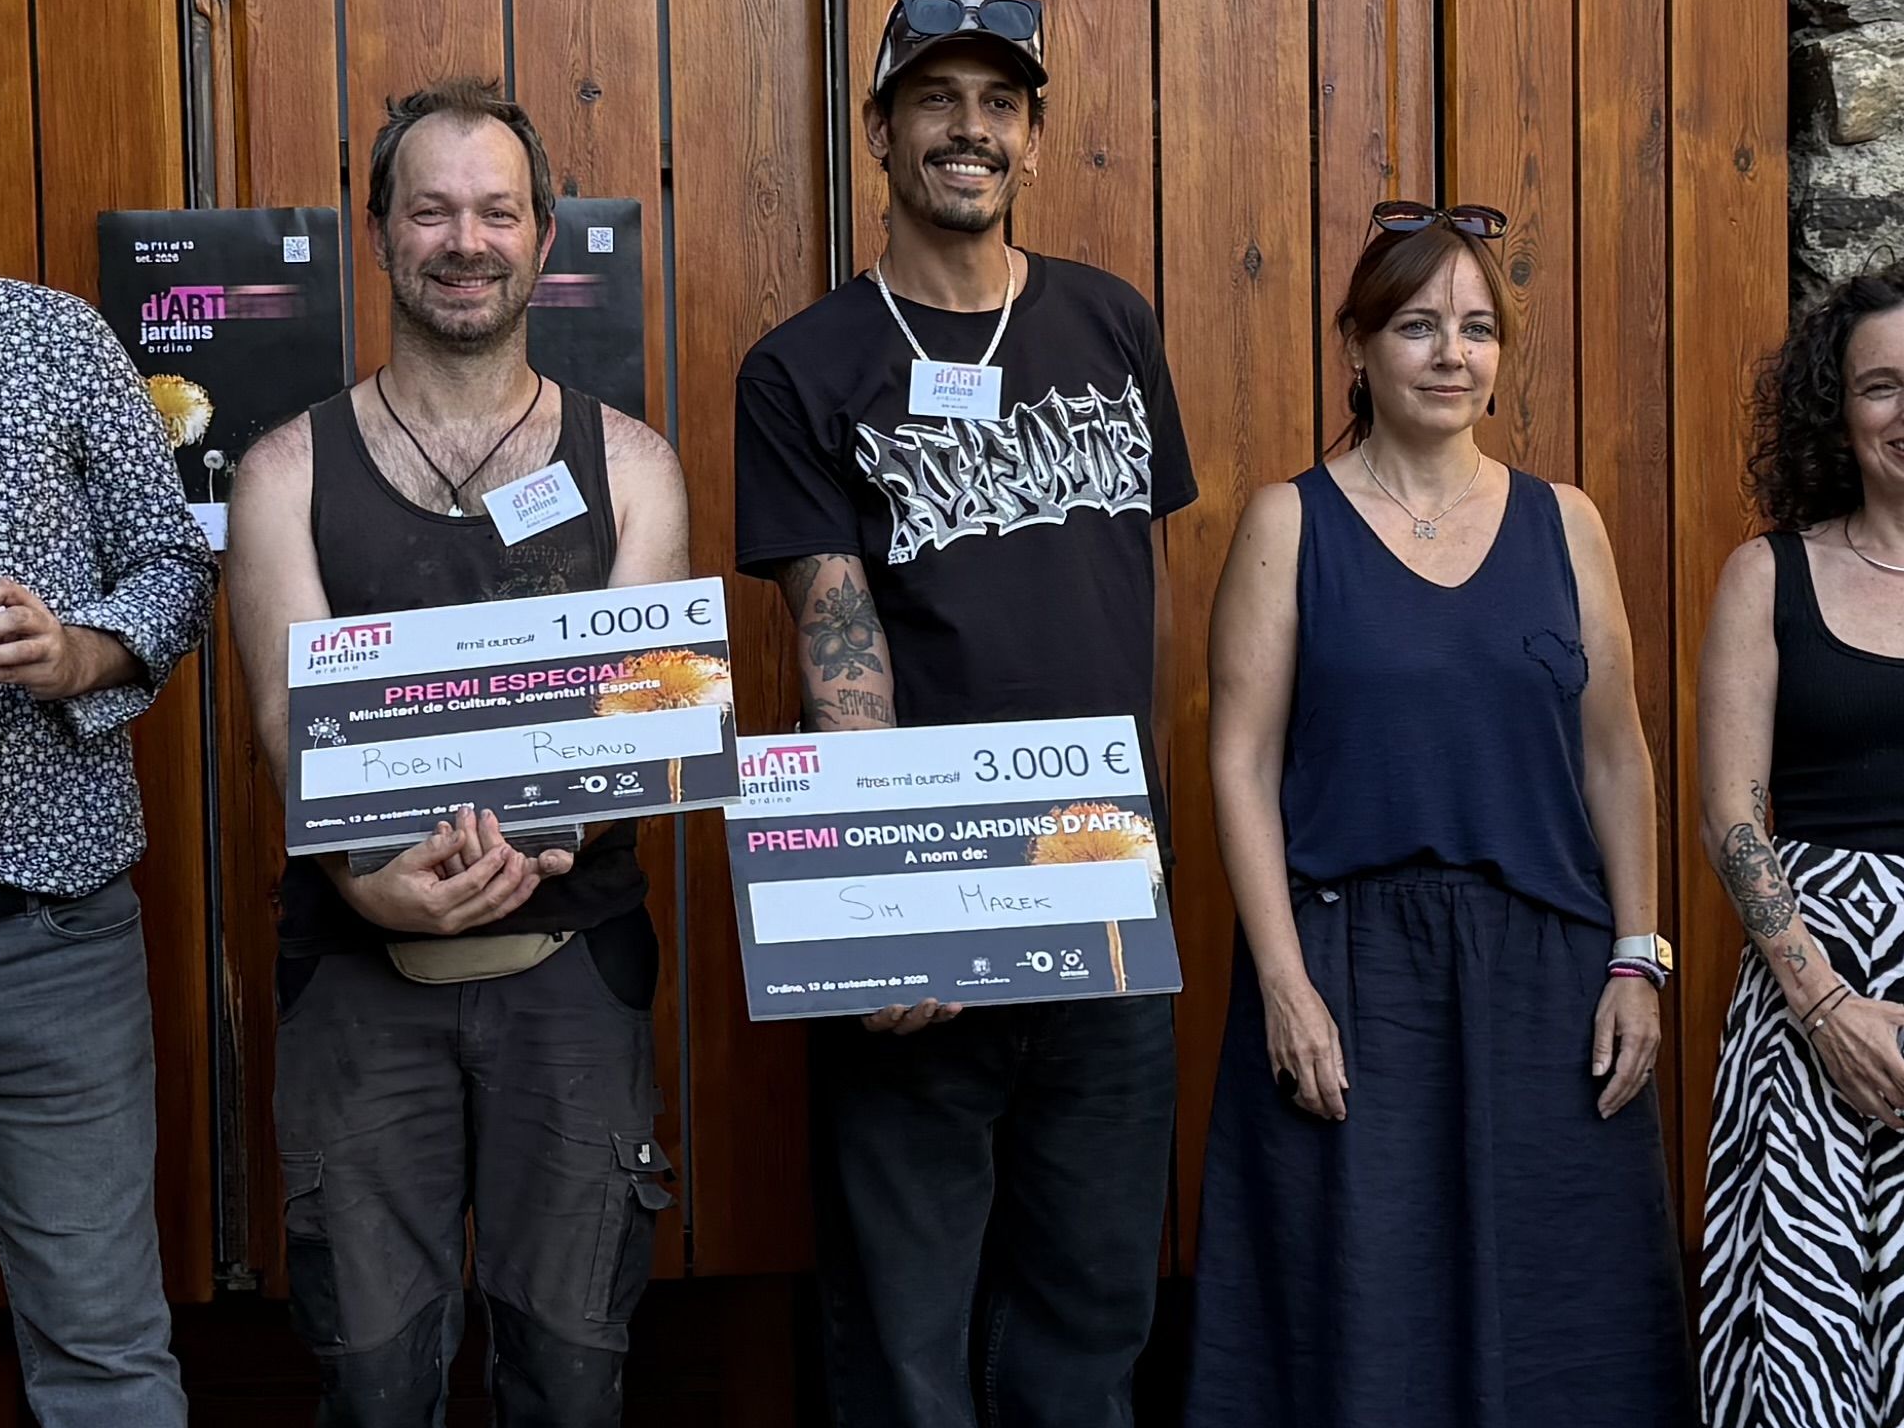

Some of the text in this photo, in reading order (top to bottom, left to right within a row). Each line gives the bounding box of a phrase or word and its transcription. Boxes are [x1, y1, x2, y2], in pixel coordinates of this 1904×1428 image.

[139, 320, 213, 345] jardins
[148, 343, 193, 353] ordino
[552, 598, 712, 640] 1.000 €
[307, 648, 380, 670] jardins
[384, 662, 634, 705] PREMI ESPECIAL
[423, 701, 445, 715] de
[515, 686, 587, 705] Joventut
[598, 678, 662, 696] Esports
[362, 730, 637, 783] ROBIN RENAUD
[973, 740, 1130, 782] 3.000 €
[741, 776, 810, 797] jardins
[749, 796, 792, 805] ordino
[748, 810, 1135, 853] PREMI ORDINO JARDINS D'ART
[905, 845, 988, 865] A nom de:
[822, 981, 835, 990] de
[888, 976, 902, 986] de
